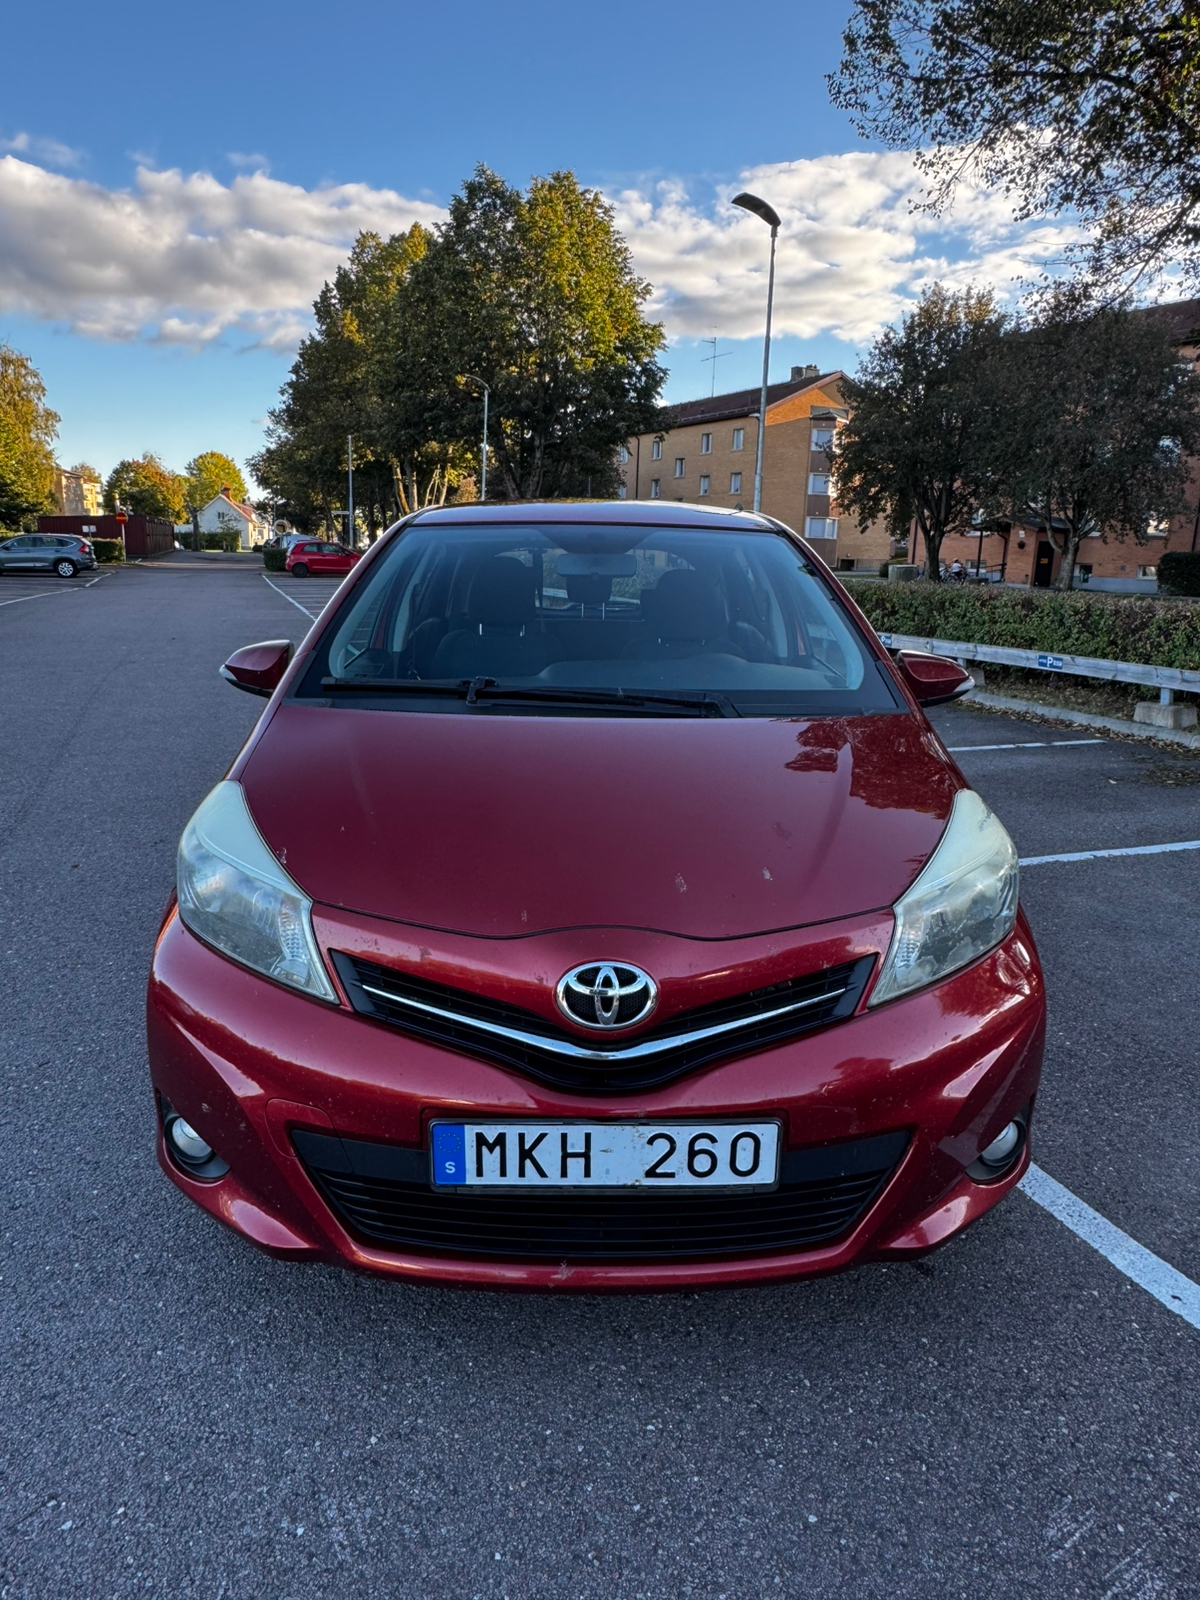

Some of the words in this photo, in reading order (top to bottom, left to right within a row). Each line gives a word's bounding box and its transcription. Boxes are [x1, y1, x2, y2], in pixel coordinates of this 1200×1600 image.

[1047, 656, 1053, 667] P
[475, 1131, 592, 1179] MKH
[644, 1131, 761, 1179] 260
[445, 1161, 456, 1174] S
